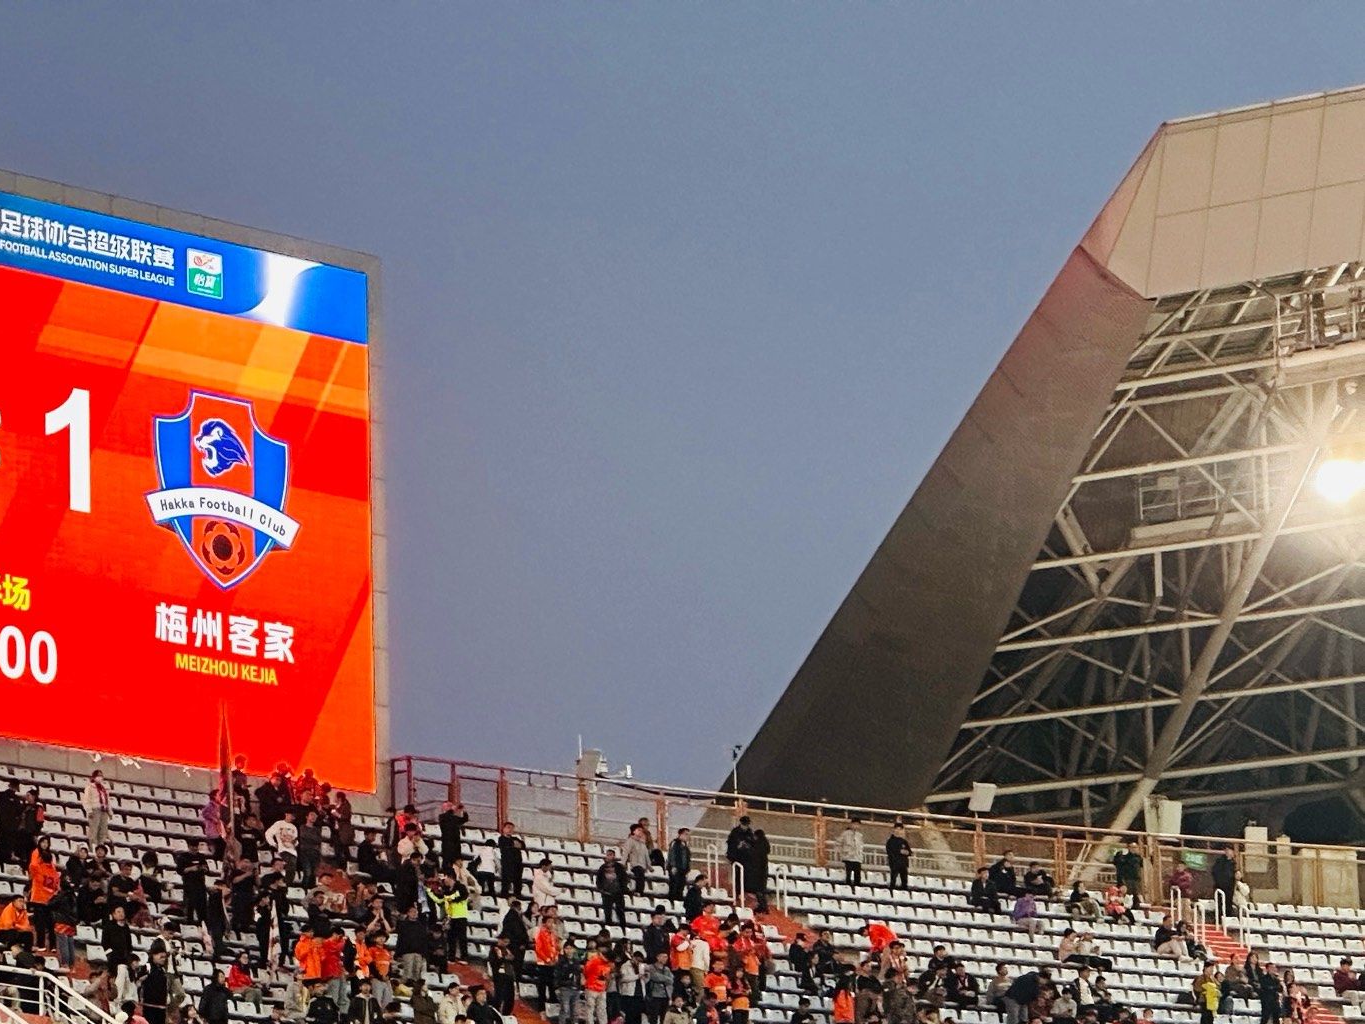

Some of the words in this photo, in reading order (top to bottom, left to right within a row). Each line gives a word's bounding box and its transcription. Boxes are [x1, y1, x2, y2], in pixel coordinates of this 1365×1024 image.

[0, 239, 47, 259] FOOTBALL
[48, 250, 108, 274] ASSOCIATION
[109, 263, 139, 280] SUPER
[139, 270, 175, 287] LEAGUE
[160, 498, 195, 512] Hakka
[199, 496, 254, 520] Football
[259, 513, 286, 537] Club
[155, 602, 295, 664] 梅州客家
[175, 652, 238, 679] MEIZHOU
[241, 666, 278, 686] KEJIA
